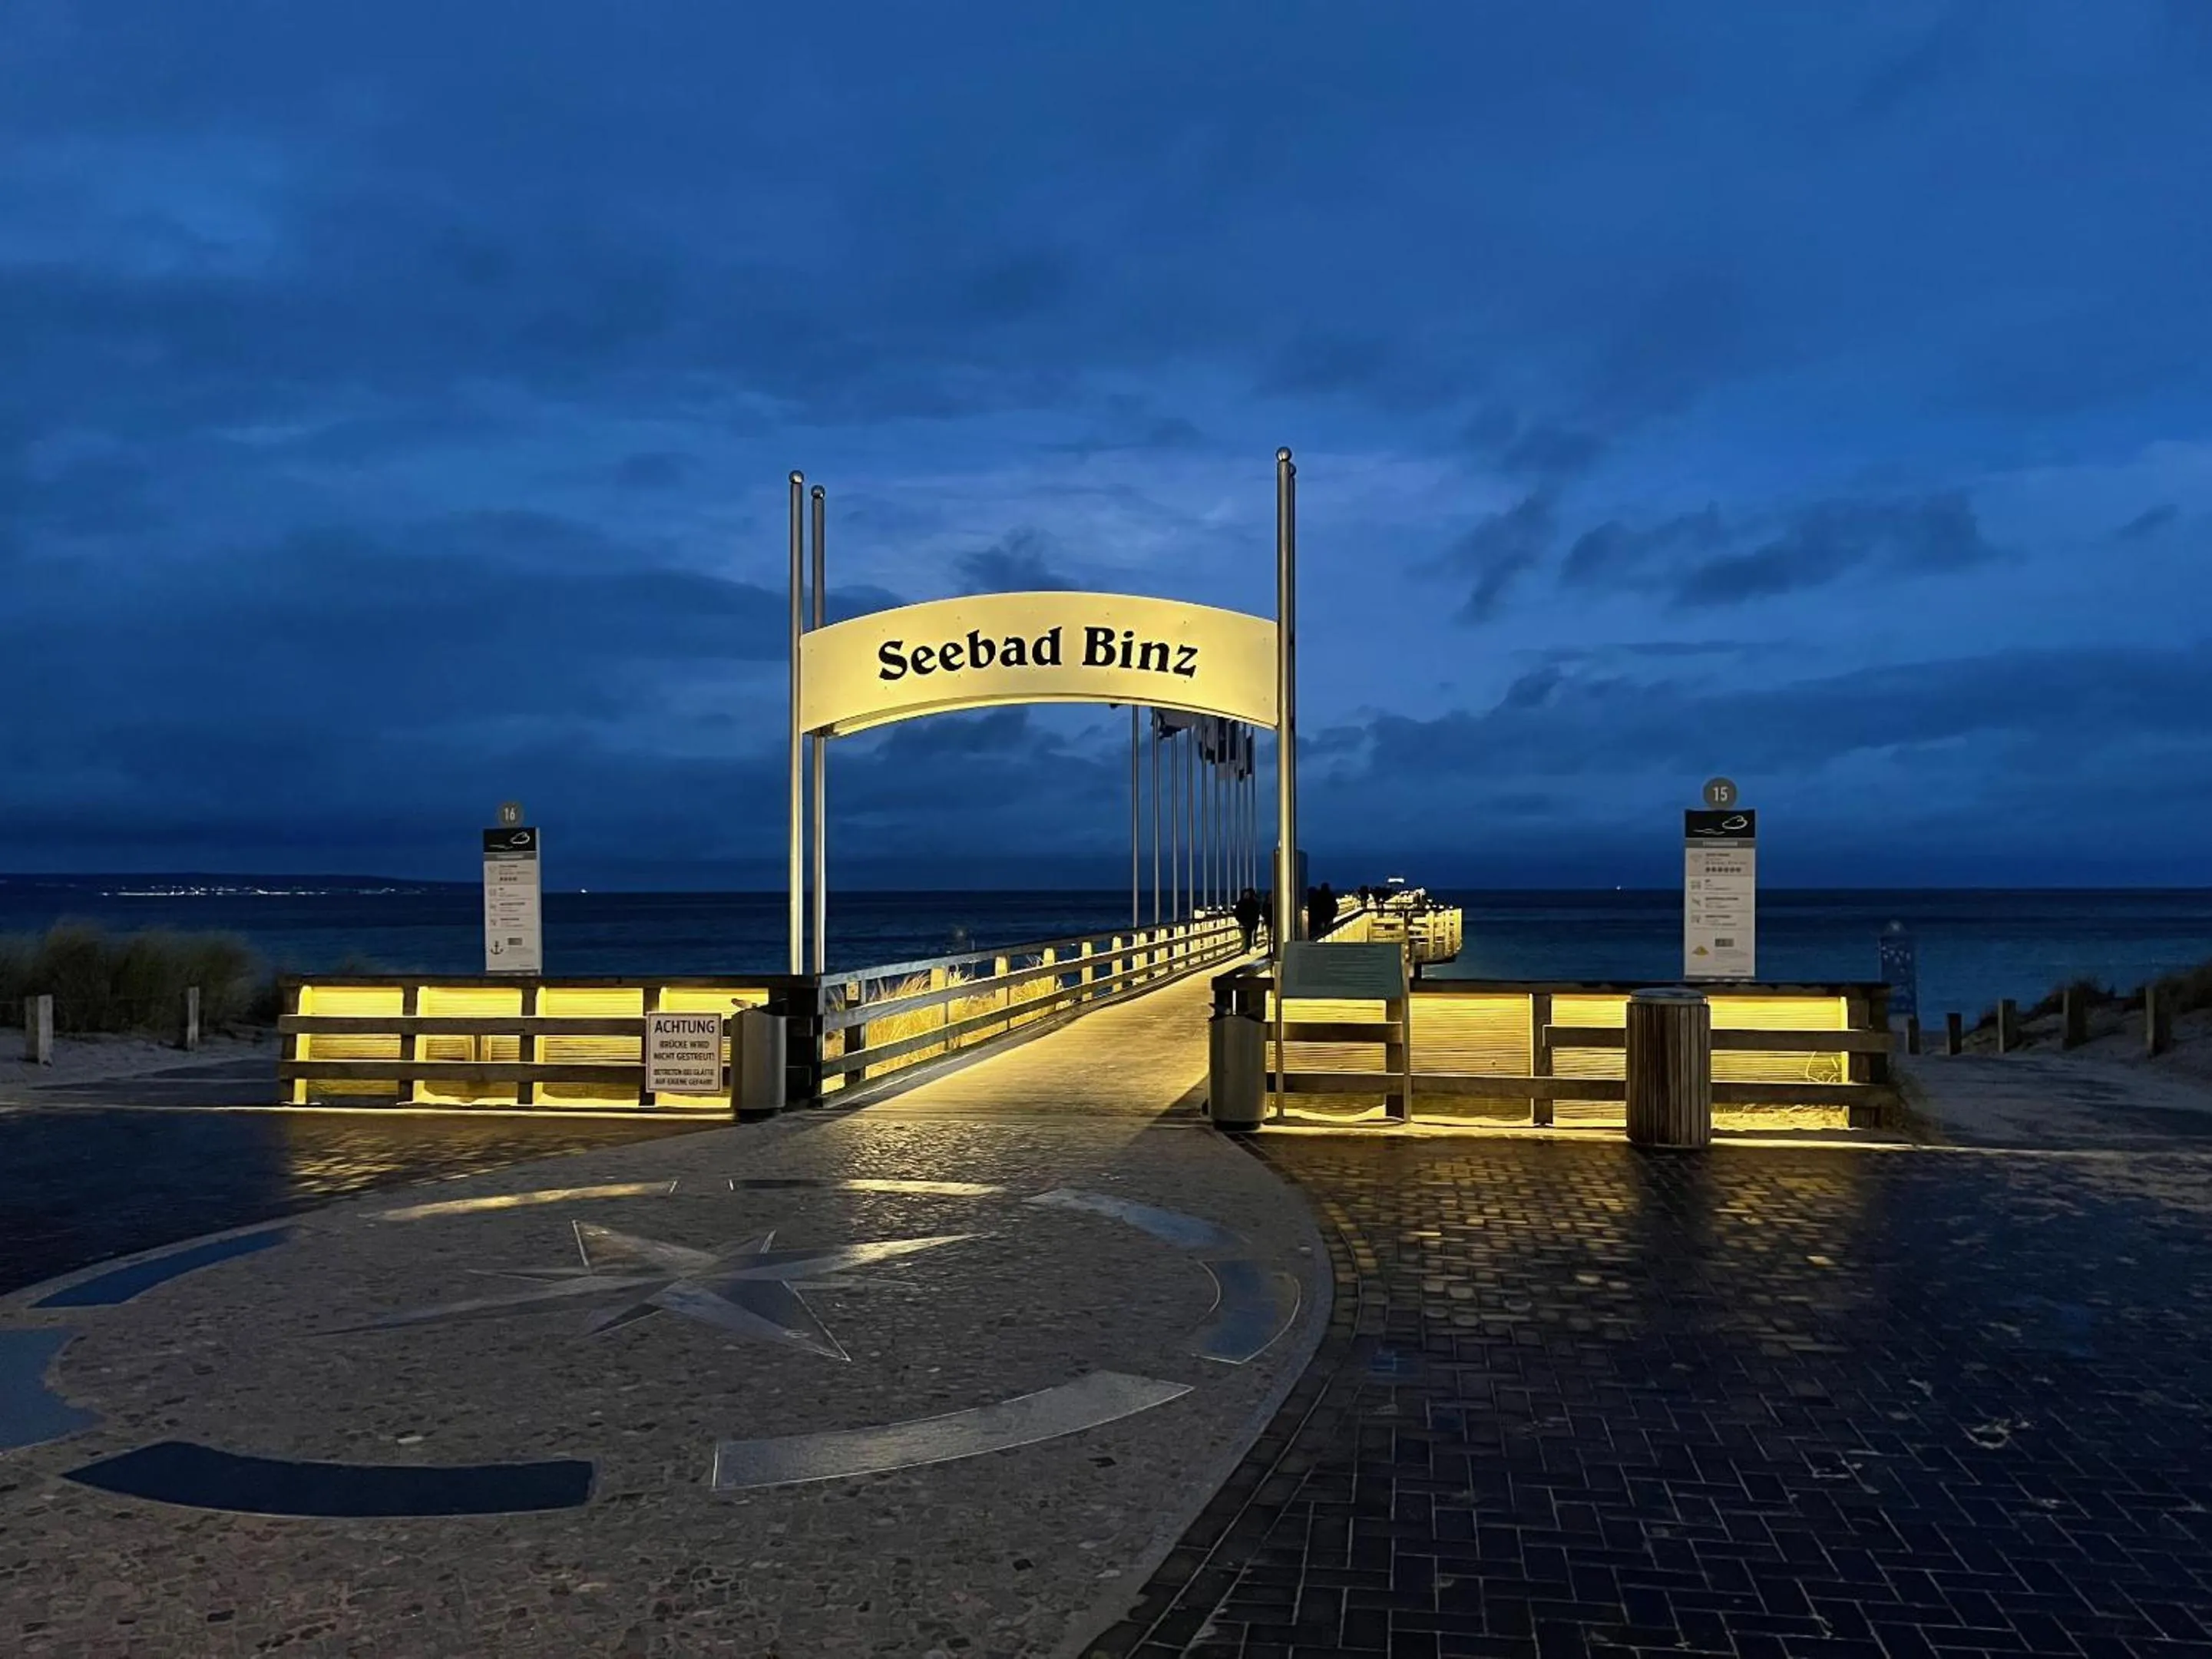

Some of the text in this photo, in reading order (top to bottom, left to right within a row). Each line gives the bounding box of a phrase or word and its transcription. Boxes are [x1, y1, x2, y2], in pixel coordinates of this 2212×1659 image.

[878, 626, 1199, 682] Seebad Binz
[1713, 786, 1728, 801] 15
[504, 807, 516, 821] 16
[654, 1020, 715, 1033] ACHTUNG
[660, 1039, 687, 1048] BRÜCKE
